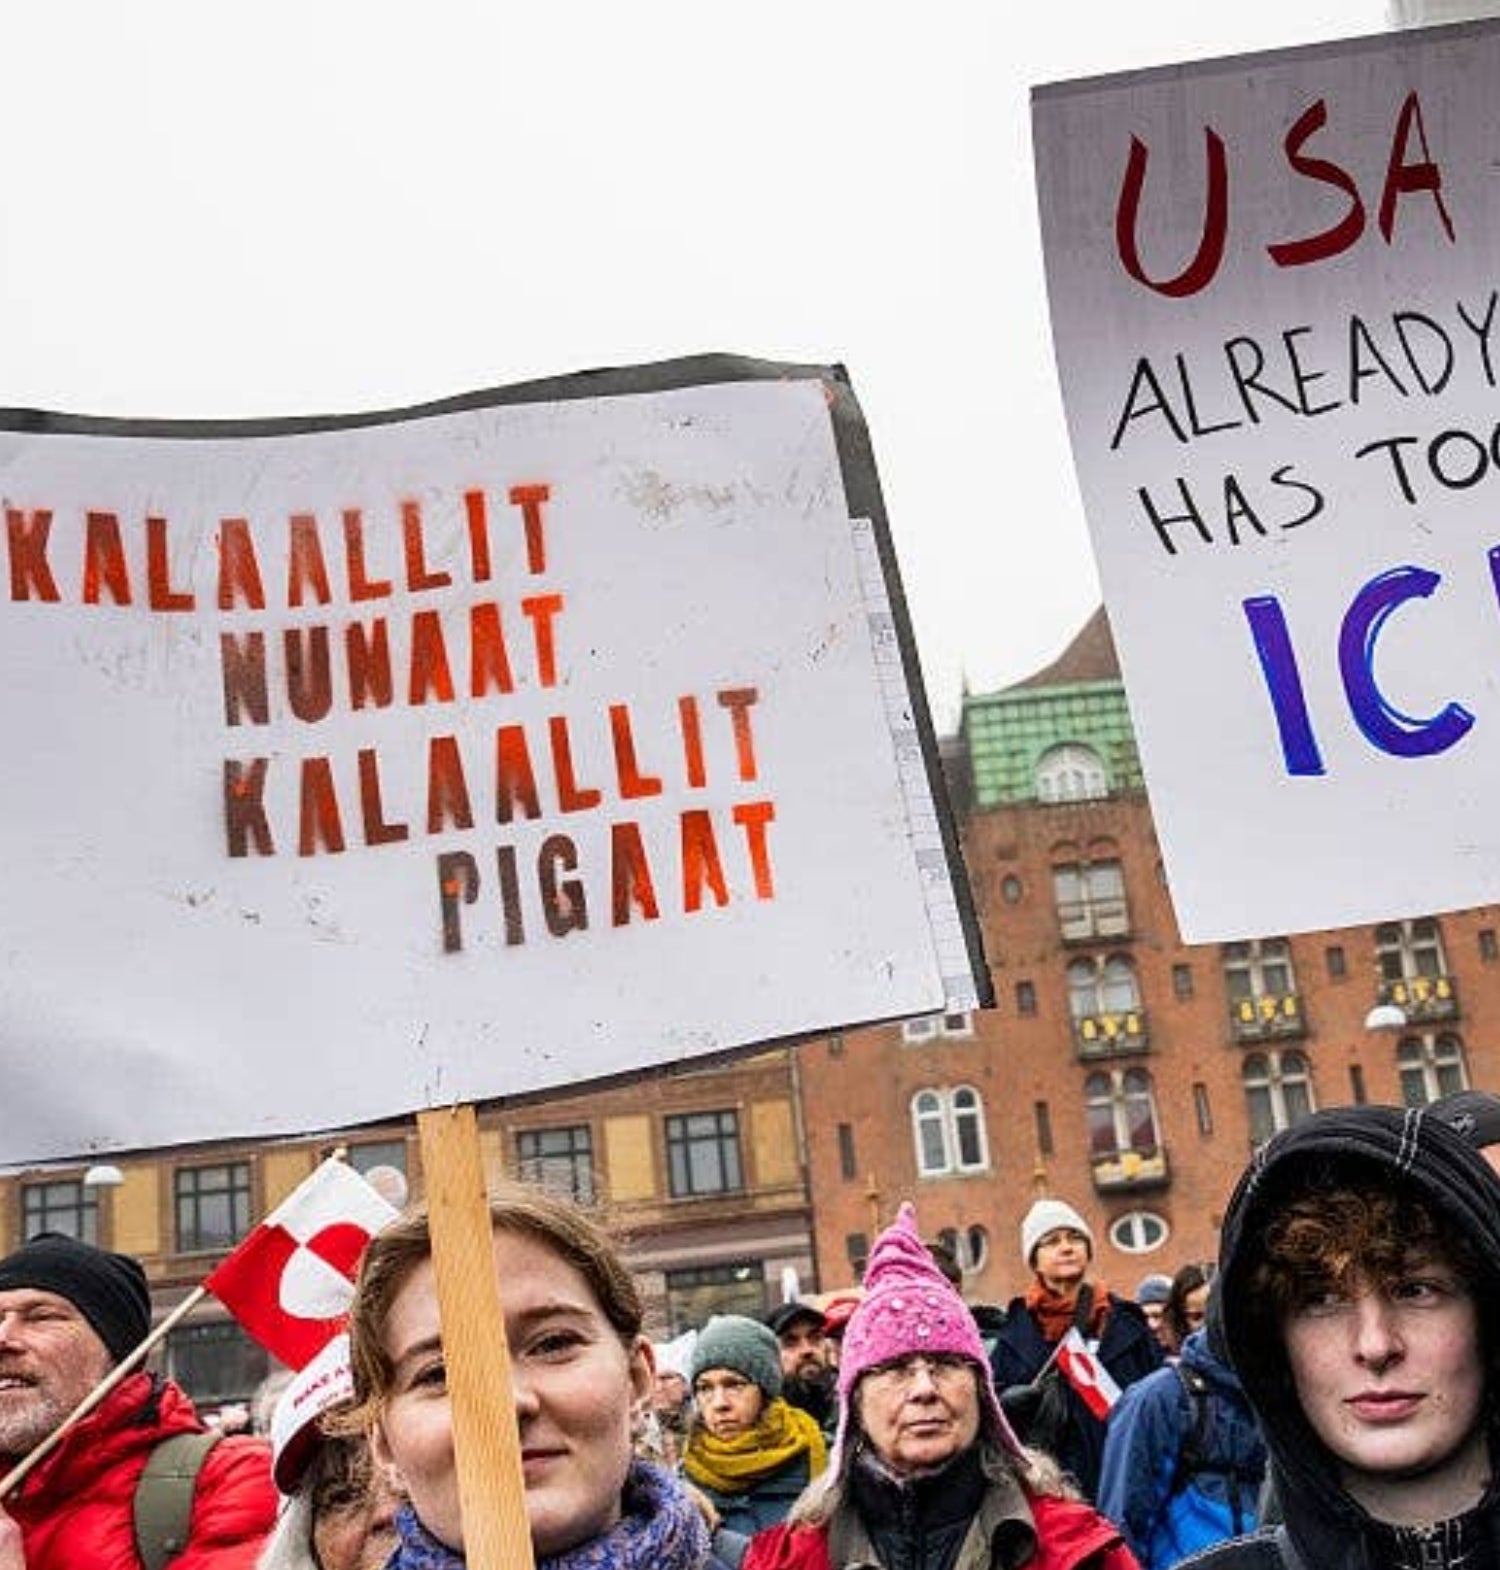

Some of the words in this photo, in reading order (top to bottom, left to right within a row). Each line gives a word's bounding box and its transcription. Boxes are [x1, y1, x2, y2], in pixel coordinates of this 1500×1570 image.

[1116, 90, 1456, 298] USA
[1111, 291, 1499, 450] ALREADY
[4, 484, 551, 612] KALAALLIT
[1138, 465, 1325, 555] HAS
[221, 594, 564, 727] NUNAAT
[224, 688, 758, 858] KALAALLIT
[437, 801, 776, 954] PIGAAT
